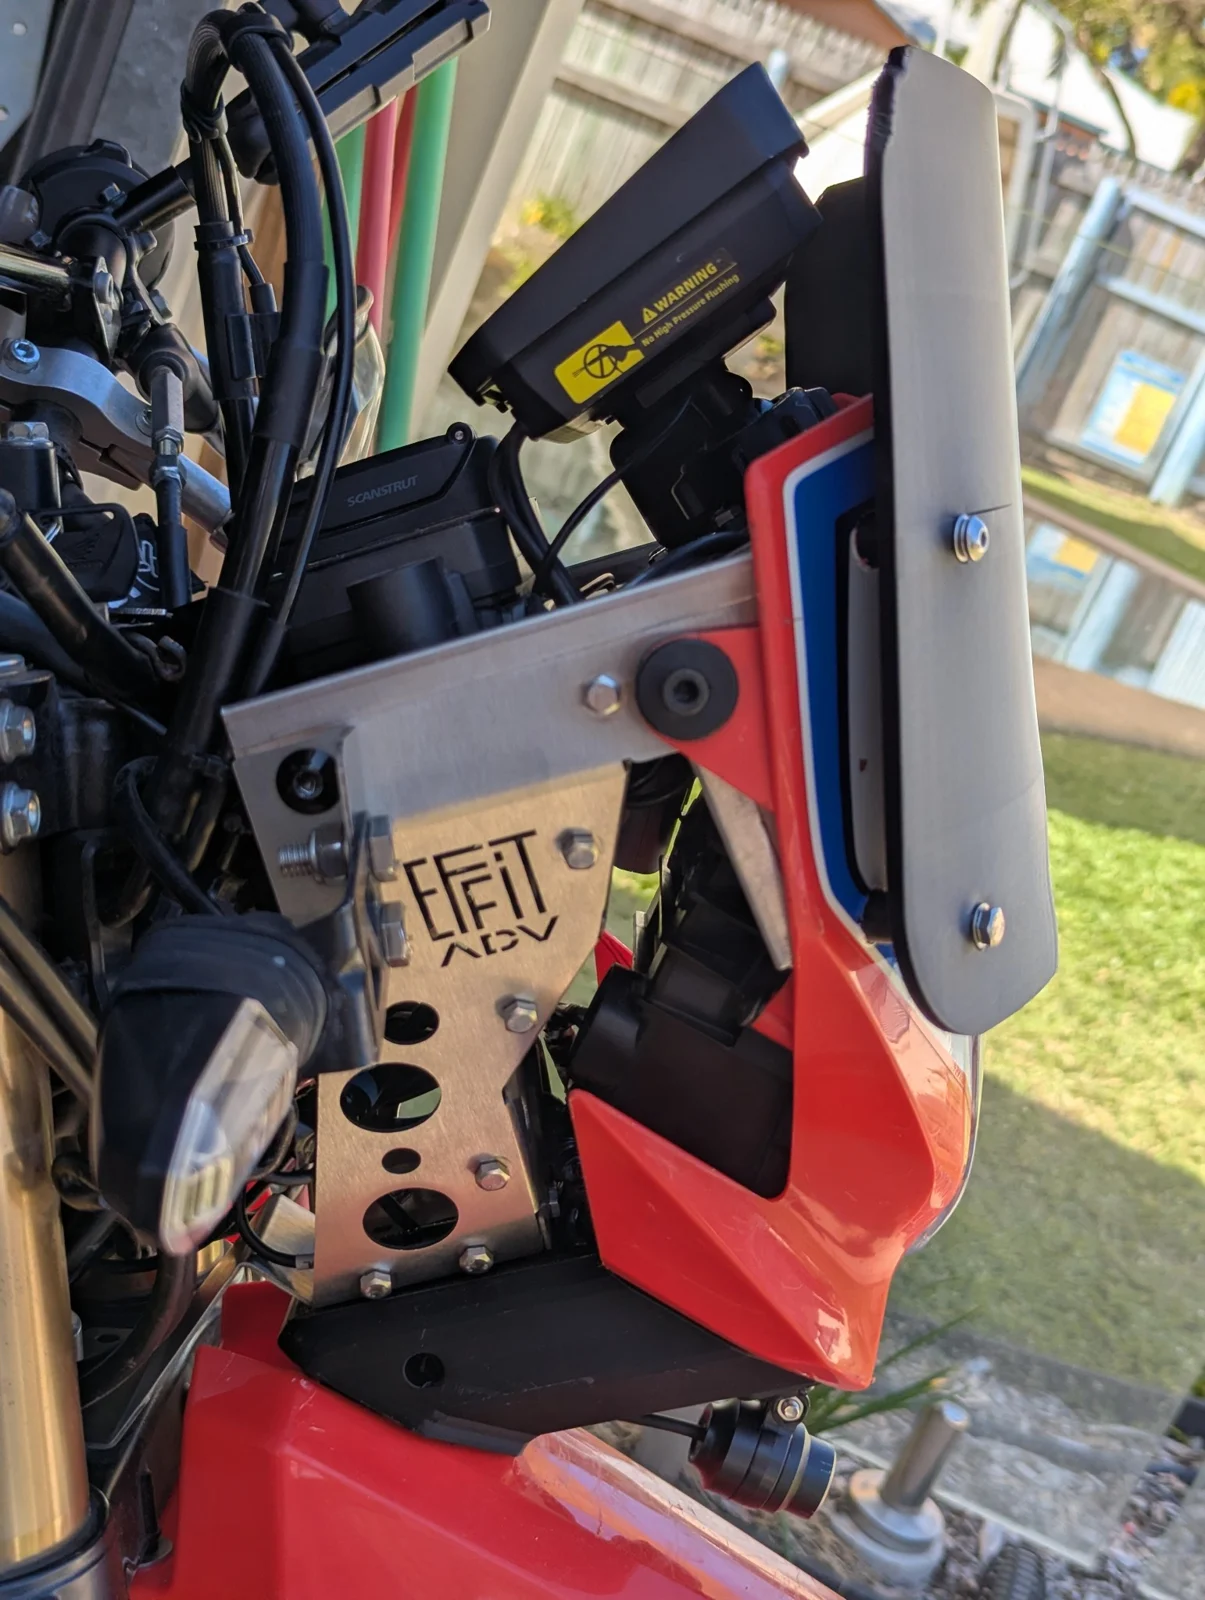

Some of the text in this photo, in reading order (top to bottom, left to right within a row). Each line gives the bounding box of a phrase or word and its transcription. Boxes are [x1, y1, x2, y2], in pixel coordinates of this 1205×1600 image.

[641, 274, 740, 347] No High Pressure Flushing
[654, 262, 718, 312] WARNING
[347, 475, 418, 508] SCANSTRUT
[441, 915, 560, 967] ADV
